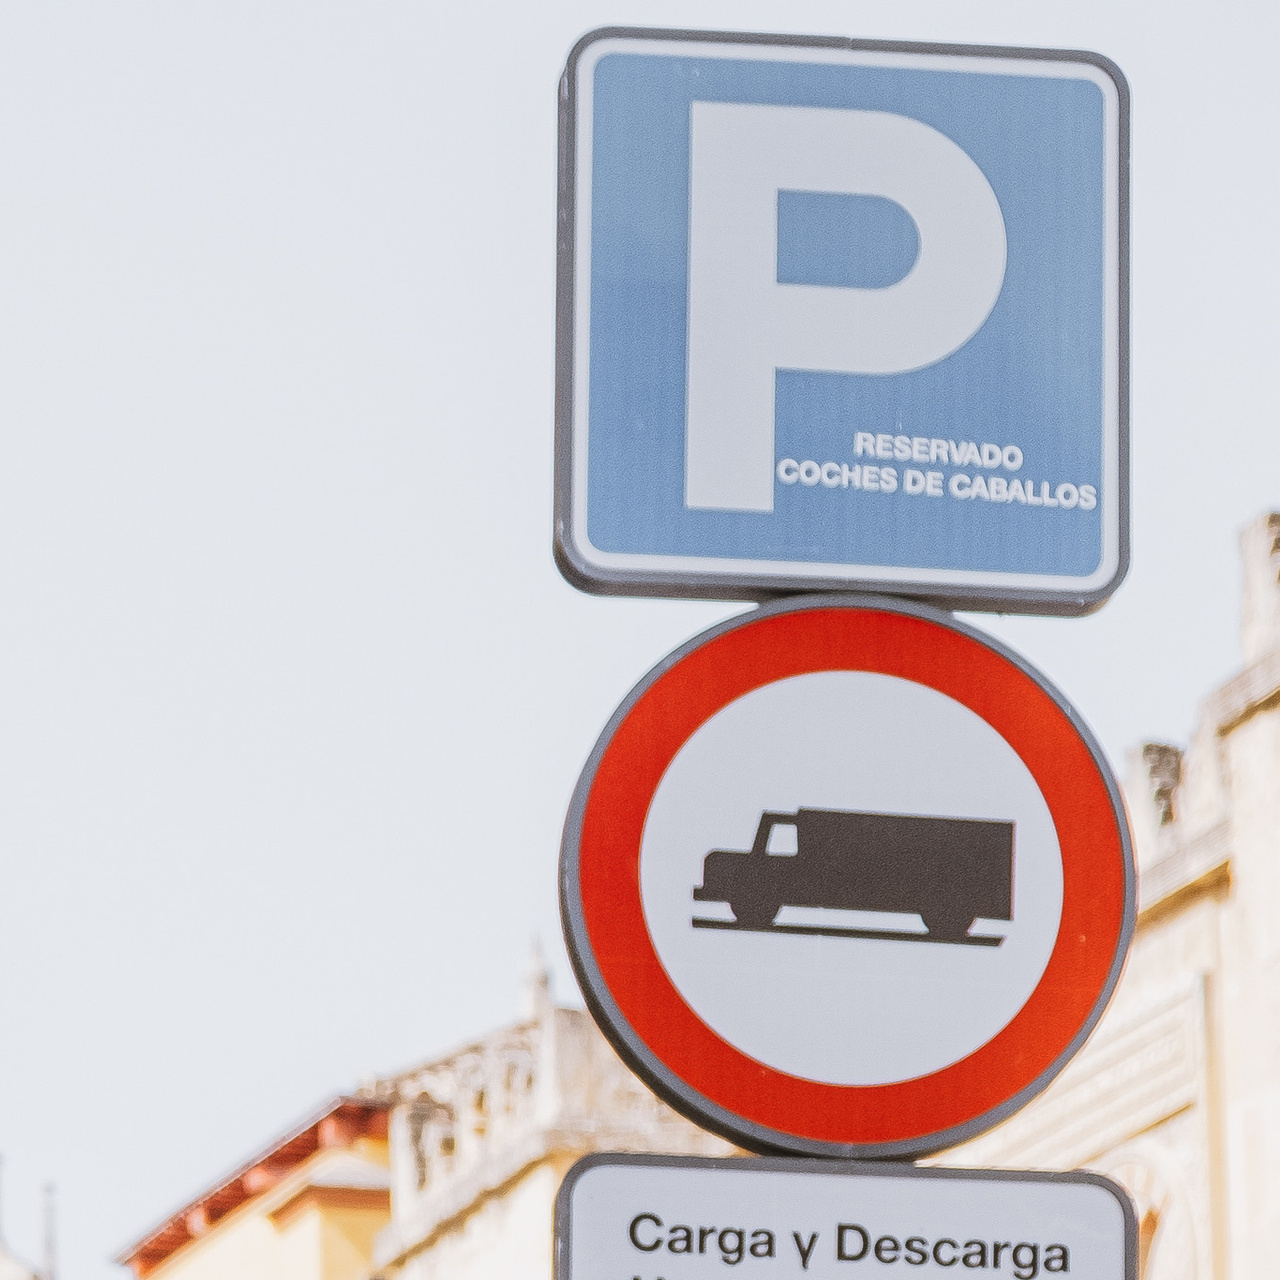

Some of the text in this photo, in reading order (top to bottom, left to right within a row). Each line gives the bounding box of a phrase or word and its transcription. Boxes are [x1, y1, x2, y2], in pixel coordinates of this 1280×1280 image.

[686, 101, 1008, 512] P
[853, 431, 1024, 471] RESERVADO
[777, 458, 1098, 511] COCHES DE CABALLOS
[628, 1211, 1071, 1280] Carga y Descarga
